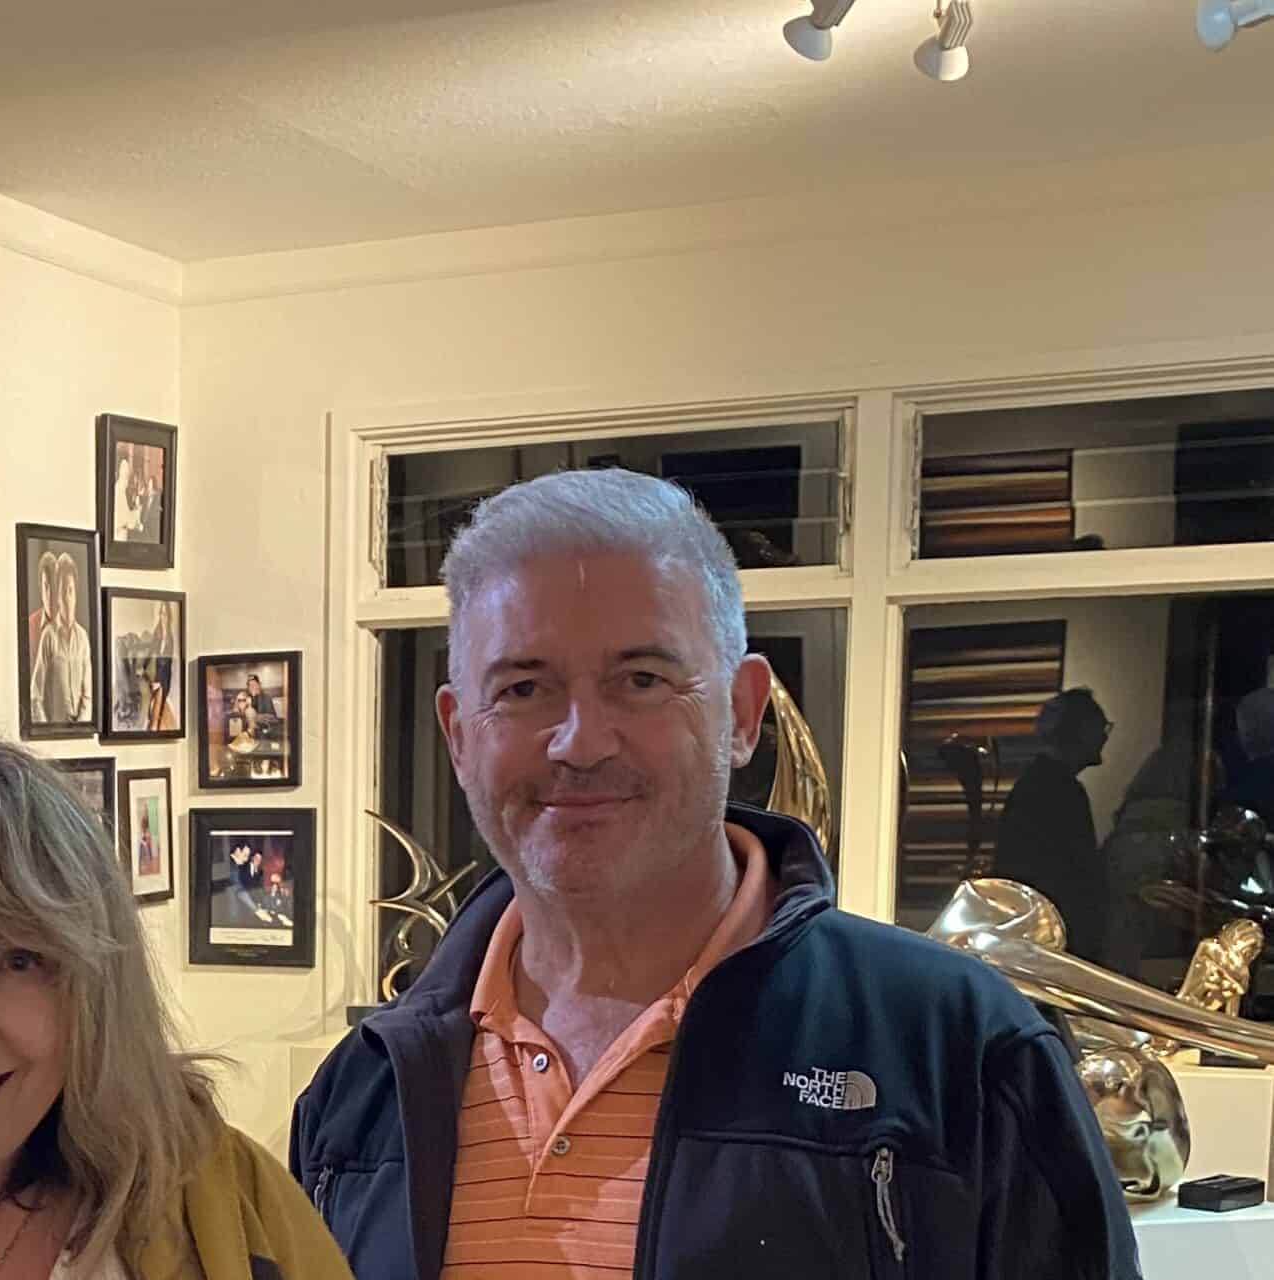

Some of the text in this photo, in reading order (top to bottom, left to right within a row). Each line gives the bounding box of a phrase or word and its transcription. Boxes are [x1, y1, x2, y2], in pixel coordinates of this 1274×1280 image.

[783, 1071, 845, 1097] NORTH
[811, 1066, 846, 1084] THE
[799, 1089, 844, 1109] FACE
